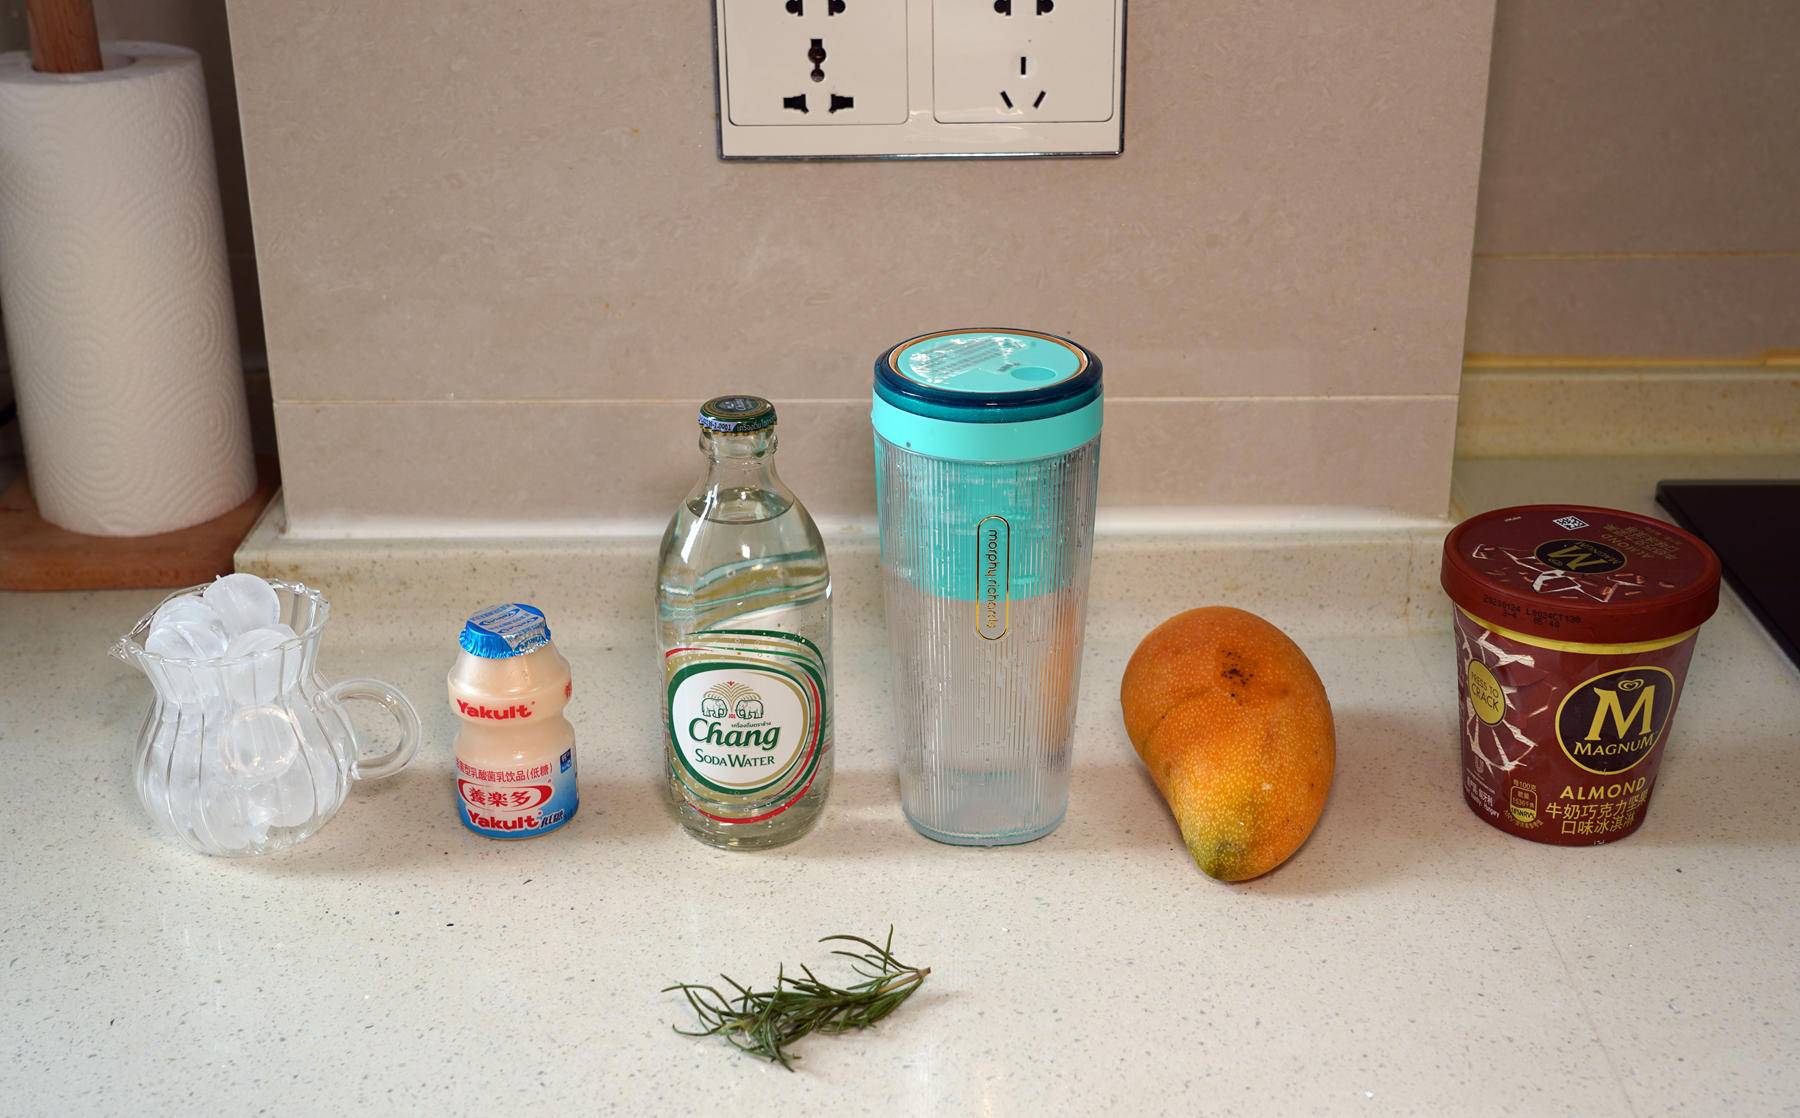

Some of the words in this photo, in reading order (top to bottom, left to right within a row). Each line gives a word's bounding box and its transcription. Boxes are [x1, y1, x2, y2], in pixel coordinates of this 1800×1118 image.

[985, 529, 1000, 576] morphy
[985, 579, 999, 629] richards
[1471, 672, 1488, 692] PRESS
[1489, 685, 1499, 698] TO
[1471, 683, 1499, 712] CRACK
[456, 698, 532, 720] Yakult
[1584, 685, 1656, 741] M
[688, 717, 781, 751] Chang
[1573, 734, 1654, 756] MAGNUM
[1560, 777, 1646, 800] ALMOND
[467, 808, 540, 830] Yakult
[1561, 811, 1636, 836] 口味冰淇淋
